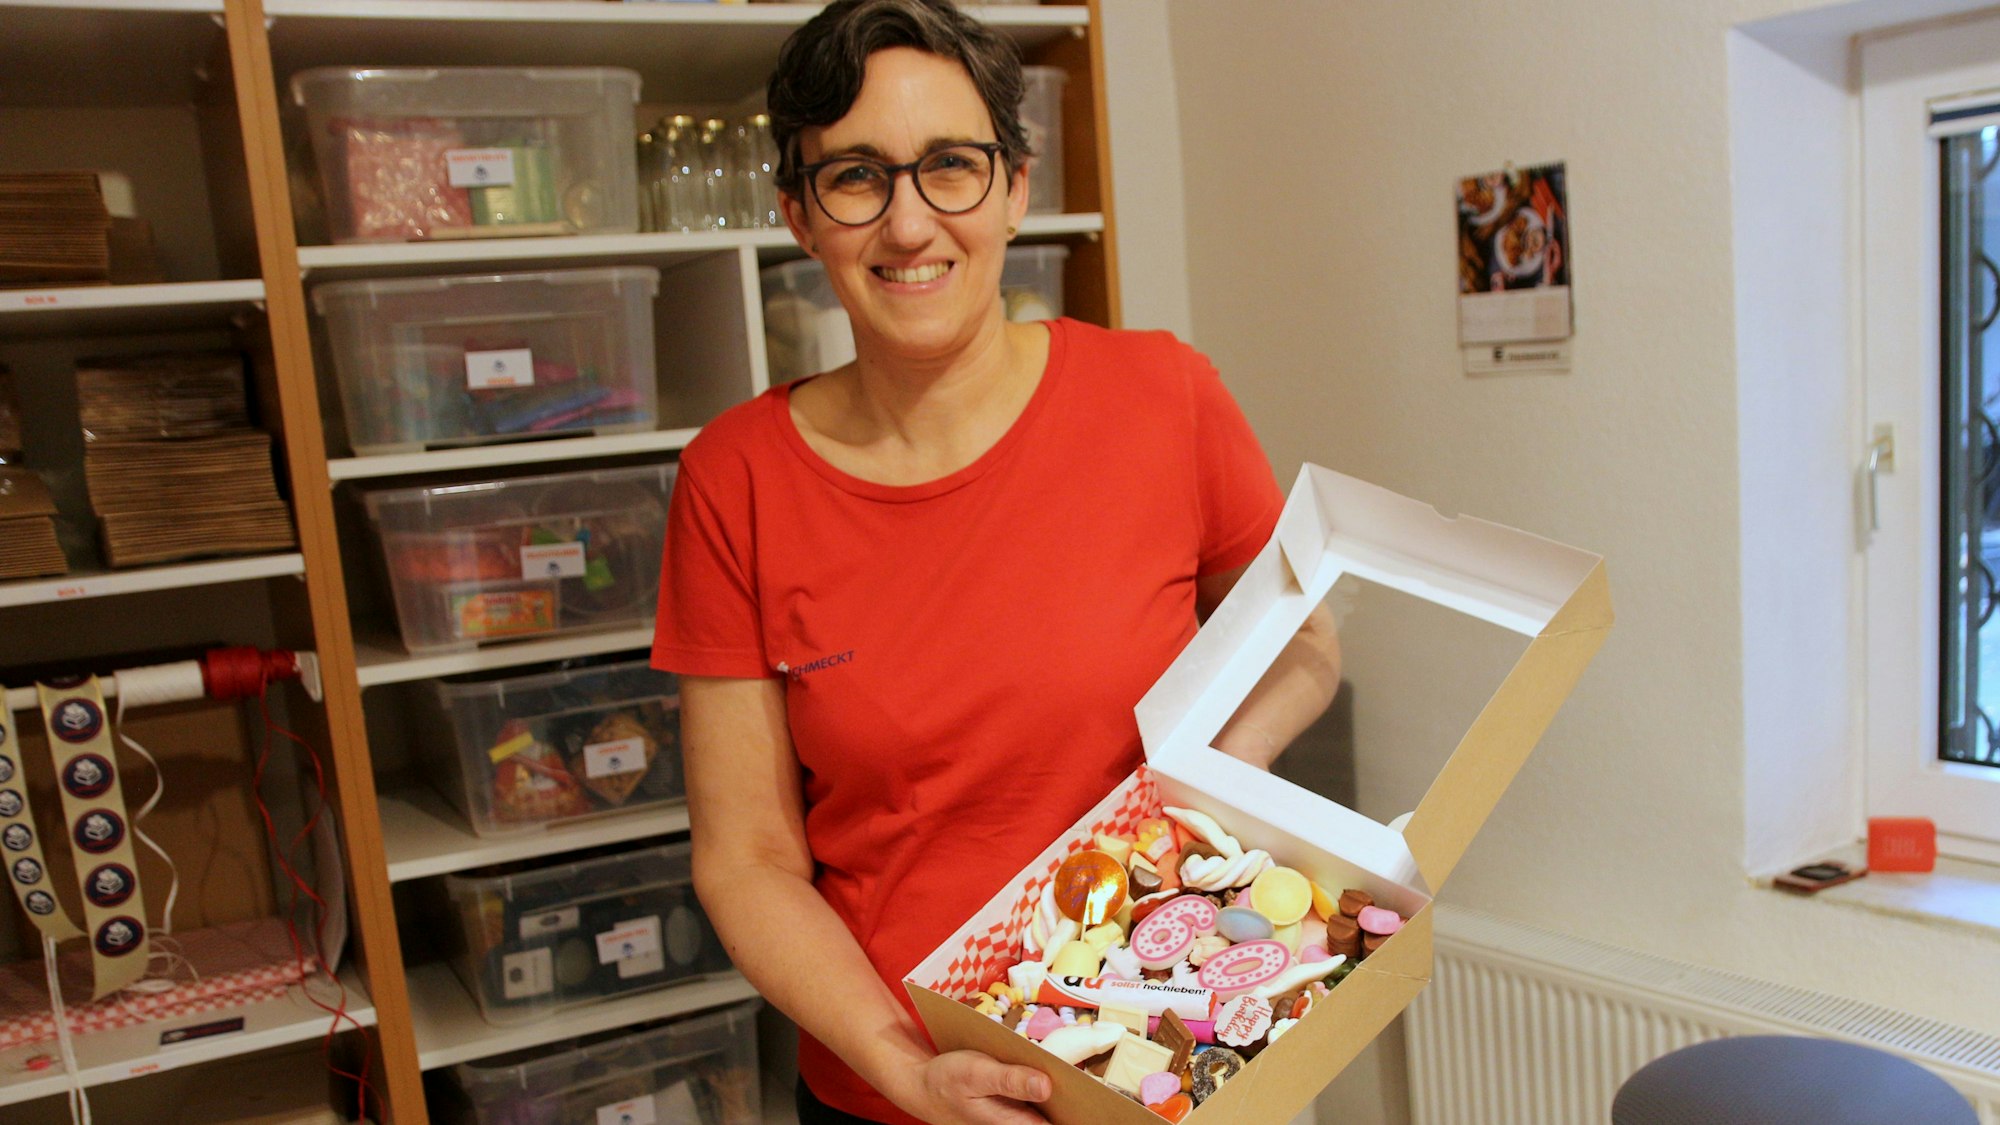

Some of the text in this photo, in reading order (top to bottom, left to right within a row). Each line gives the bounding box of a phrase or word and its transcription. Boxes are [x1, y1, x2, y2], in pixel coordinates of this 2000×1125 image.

[789, 650, 854, 677] CHMECKT
[1111, 980, 1140, 989] sollst
[1143, 983, 1207, 996] hochleben!
[1236, 1006, 1272, 1040] Happy
